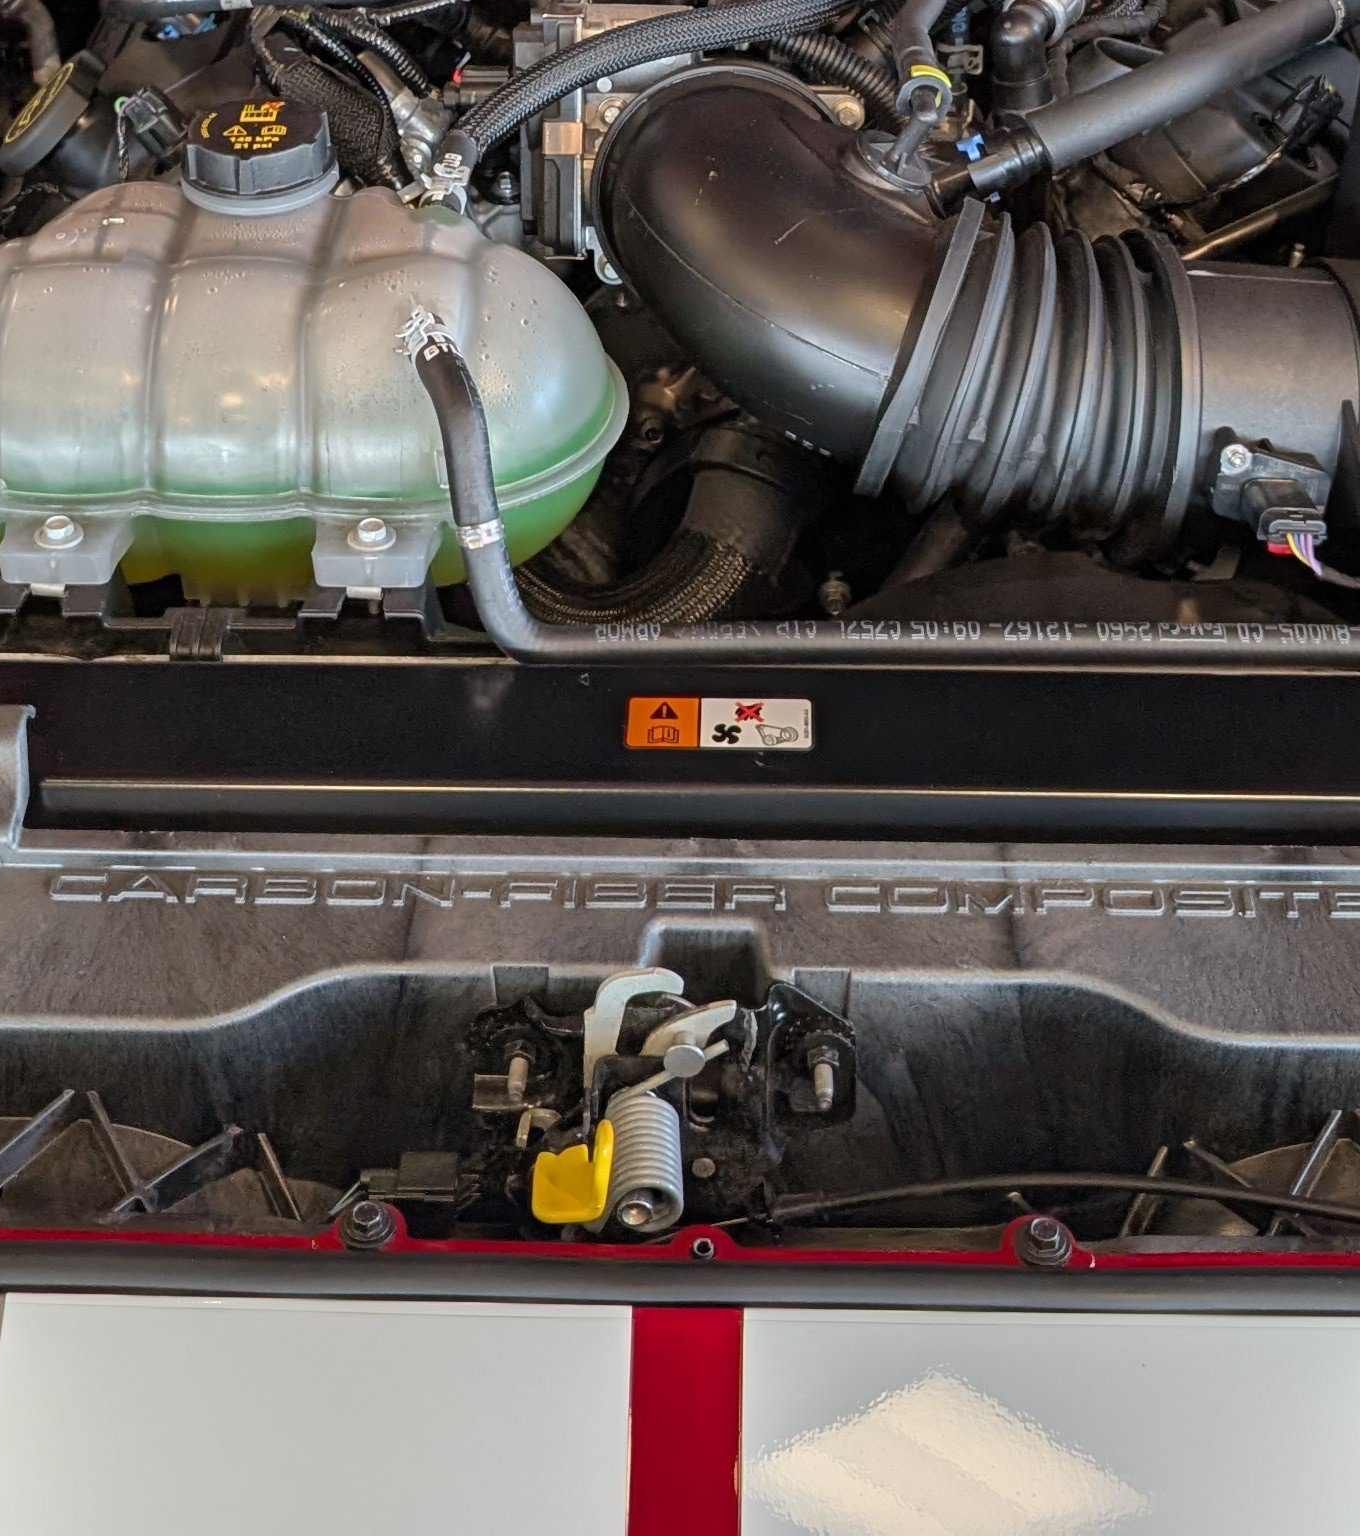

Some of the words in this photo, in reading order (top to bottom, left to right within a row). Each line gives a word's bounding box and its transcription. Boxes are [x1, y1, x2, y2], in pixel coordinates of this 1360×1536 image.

[252, 142, 273, 150] psi
[593, 622, 661, 644] ARMOR
[49, 871, 788, 911] CARBON-FIBER
